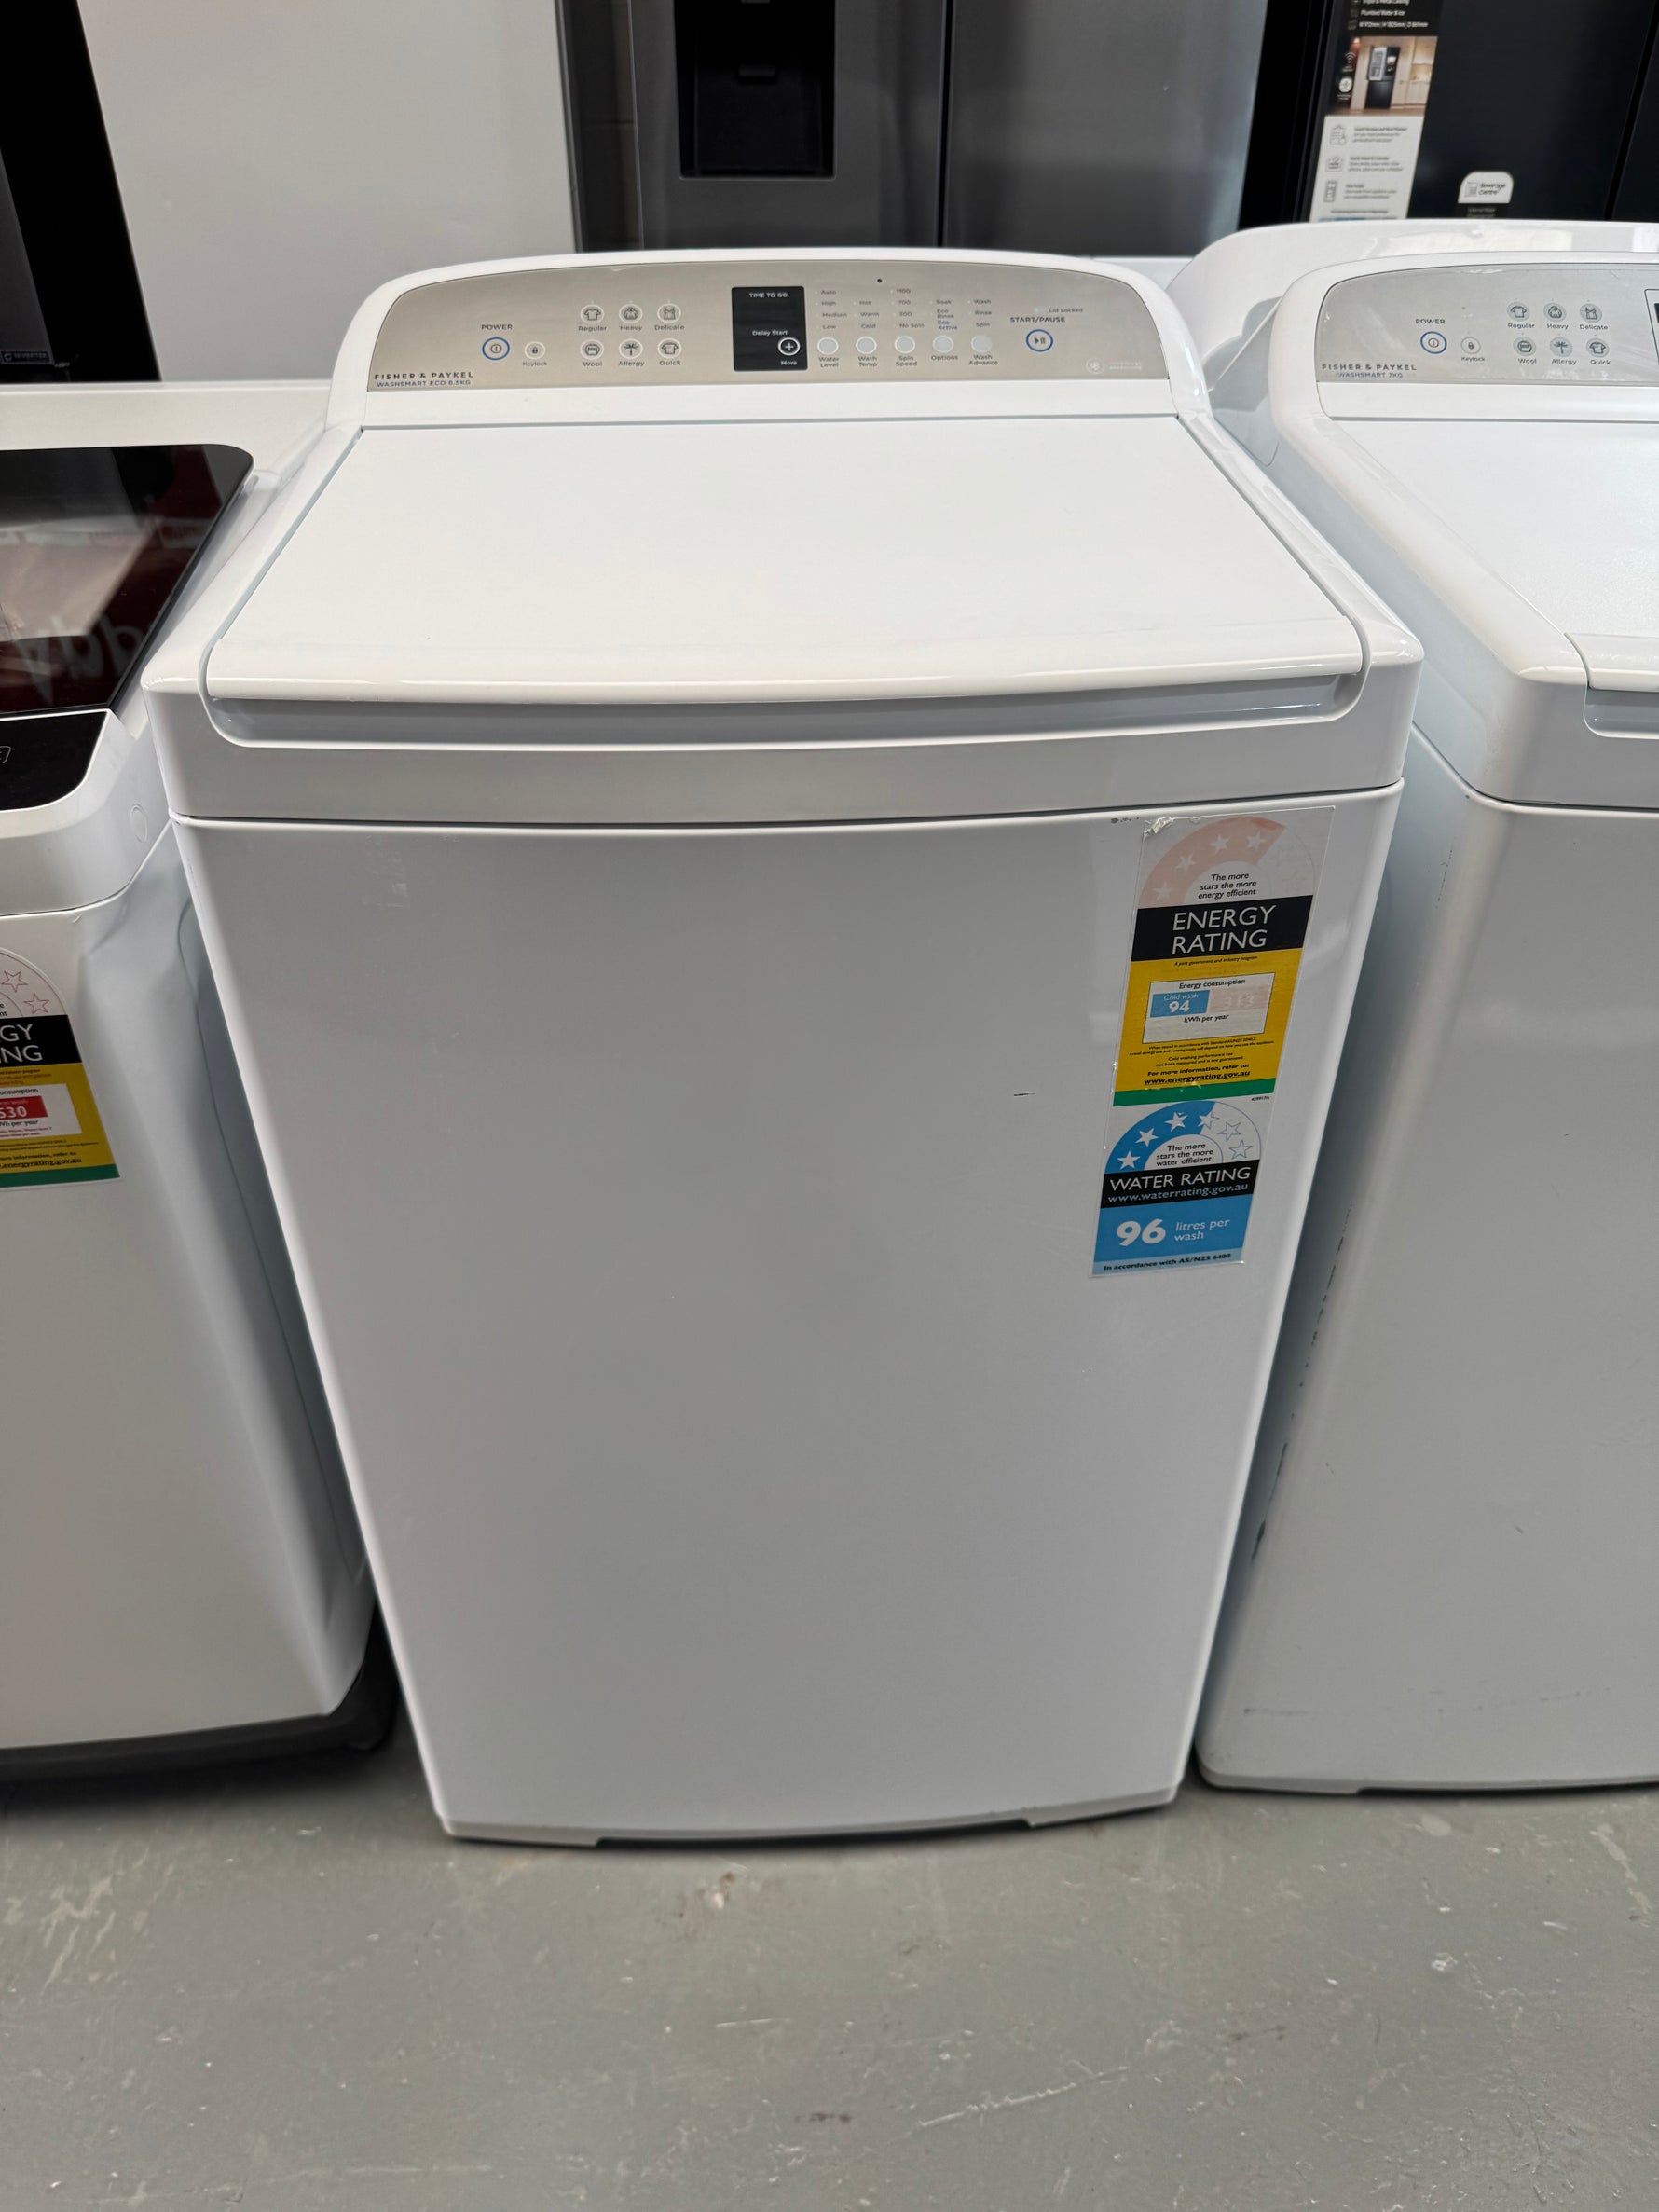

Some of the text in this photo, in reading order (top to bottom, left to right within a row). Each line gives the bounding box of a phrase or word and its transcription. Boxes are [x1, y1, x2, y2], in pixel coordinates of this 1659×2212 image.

[619, 324, 643, 333] Heavy
[618, 360, 645, 368] Allergy
[1551, 358, 1577, 366] Allergy
[375, 373, 416, 381] FISHER
[432, 371, 474, 379] PAYKEL
[1211, 873, 1226, 882] The
[1198, 888, 1256, 900] energy efficient
[1172, 905, 1277, 931] ENERGY
[1172, 929, 1268, 955] RATING
[1179, 978, 1246, 991] Energy consumption
[1163, 992, 1199, 1002] Cold wash
[1168, 1001, 1190, 1014] 94
[1184, 1014, 1229, 1024] kWh per year
[1180, 1066, 1221, 1075] information,
[1144, 1070, 1250, 1085] www.energyrating.gov.au
[1181, 1156, 1212, 1164] efficient
[1109, 1166, 1251, 1191] WATER RATING
[1107, 1183, 1249, 1203] www.waterrating.gov.au
[1116, 1218, 1230, 1247] 96 litres per
[1114, 1261, 1158, 1270] accordance
[1178, 1255, 1211, 1264] AS/NZS
